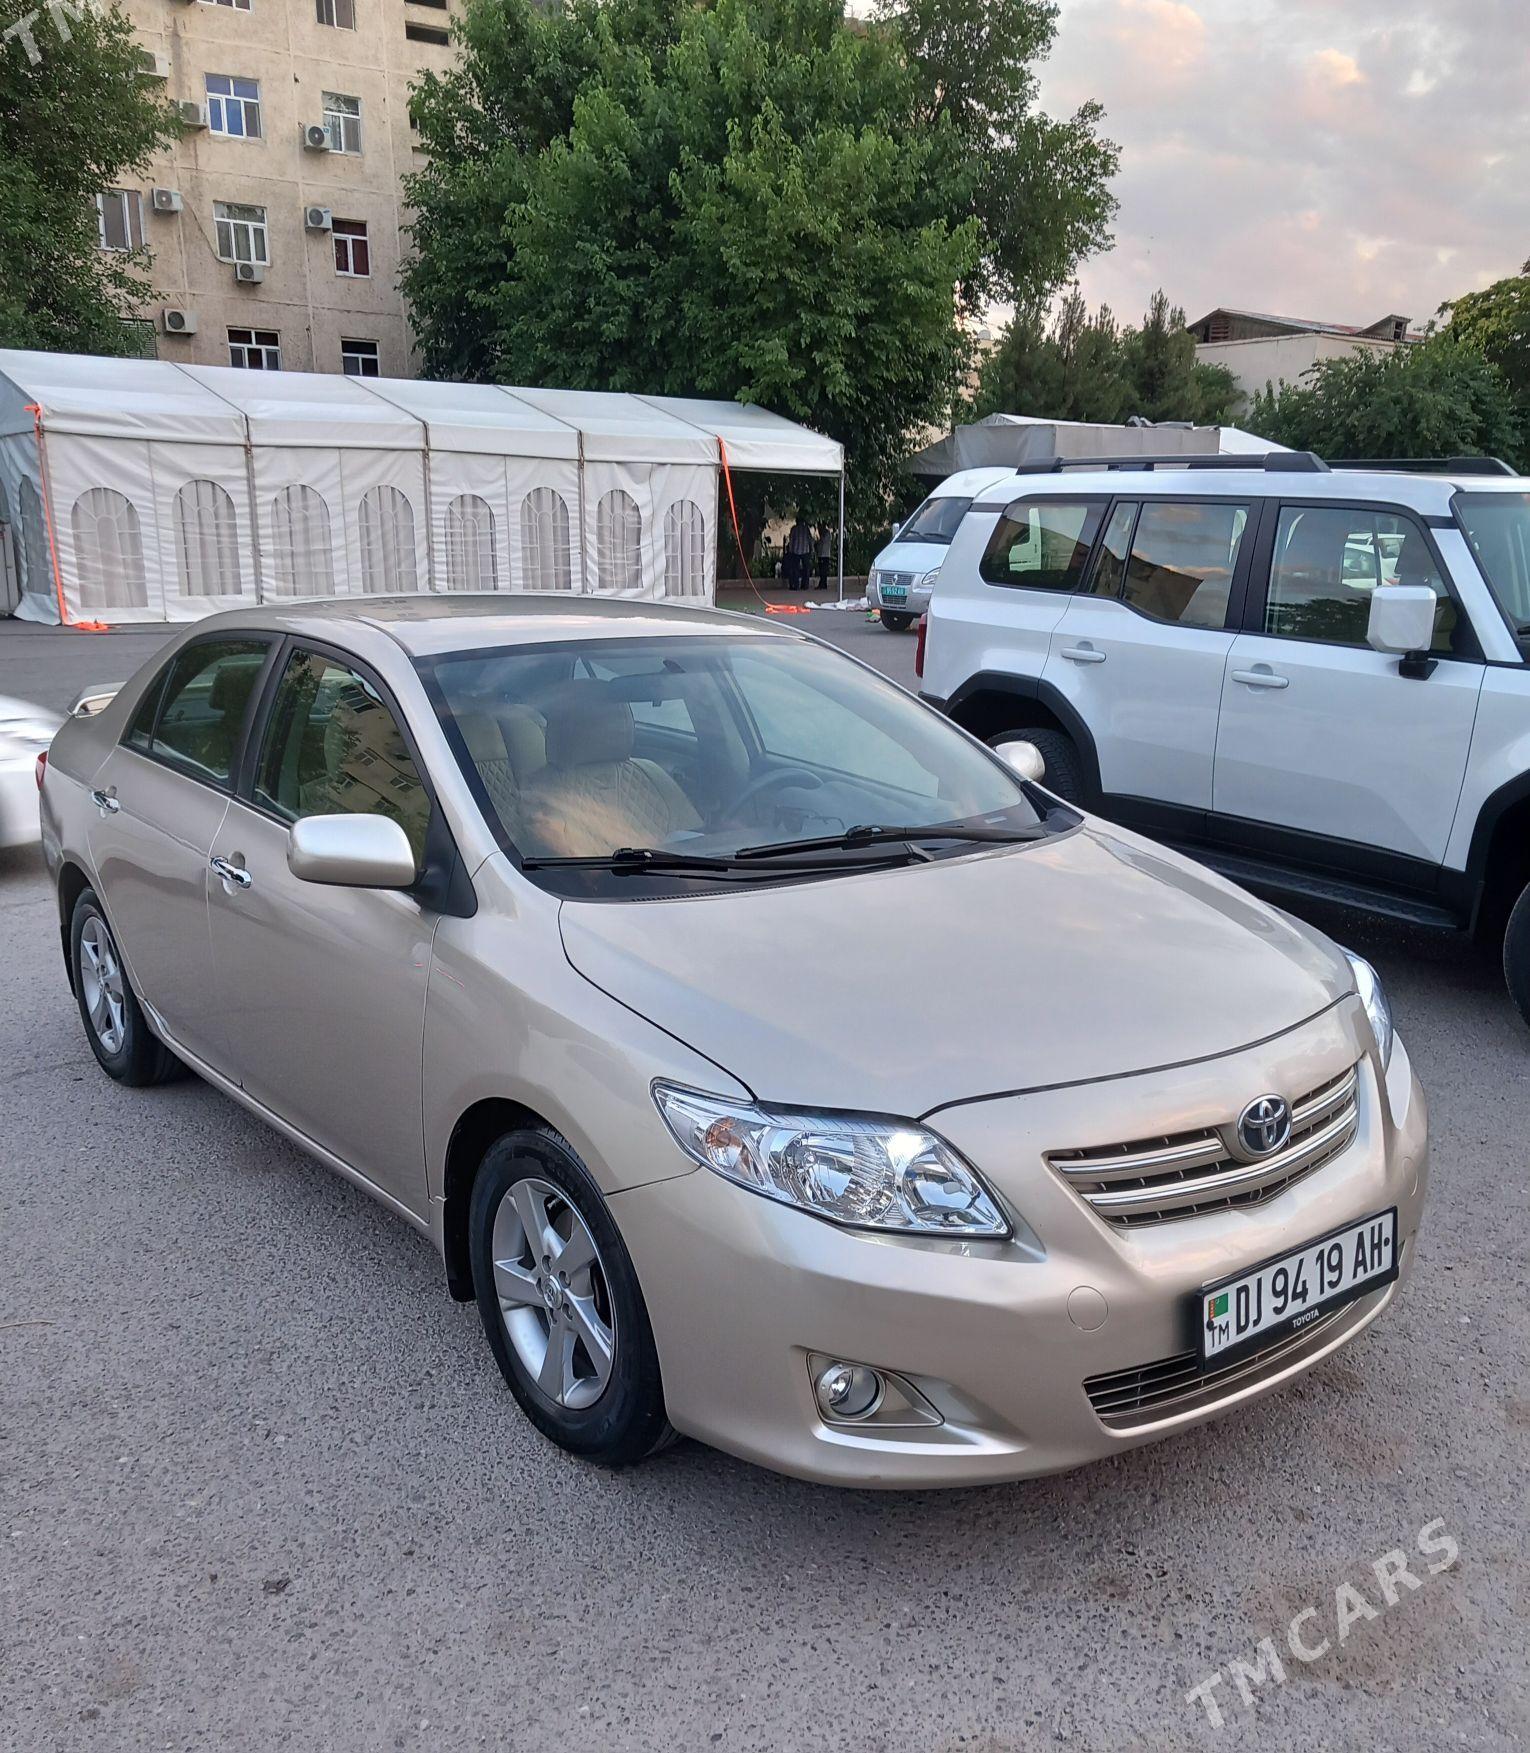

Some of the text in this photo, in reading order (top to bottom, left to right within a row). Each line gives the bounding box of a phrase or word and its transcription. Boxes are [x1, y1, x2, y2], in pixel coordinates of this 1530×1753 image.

[1236, 1277, 1262, 1336] DJ
[1352, 1222, 1383, 1280] AH
[1292, 1308, 1320, 1328] TOYOTA
[1208, 1320, 1230, 1348] TM
